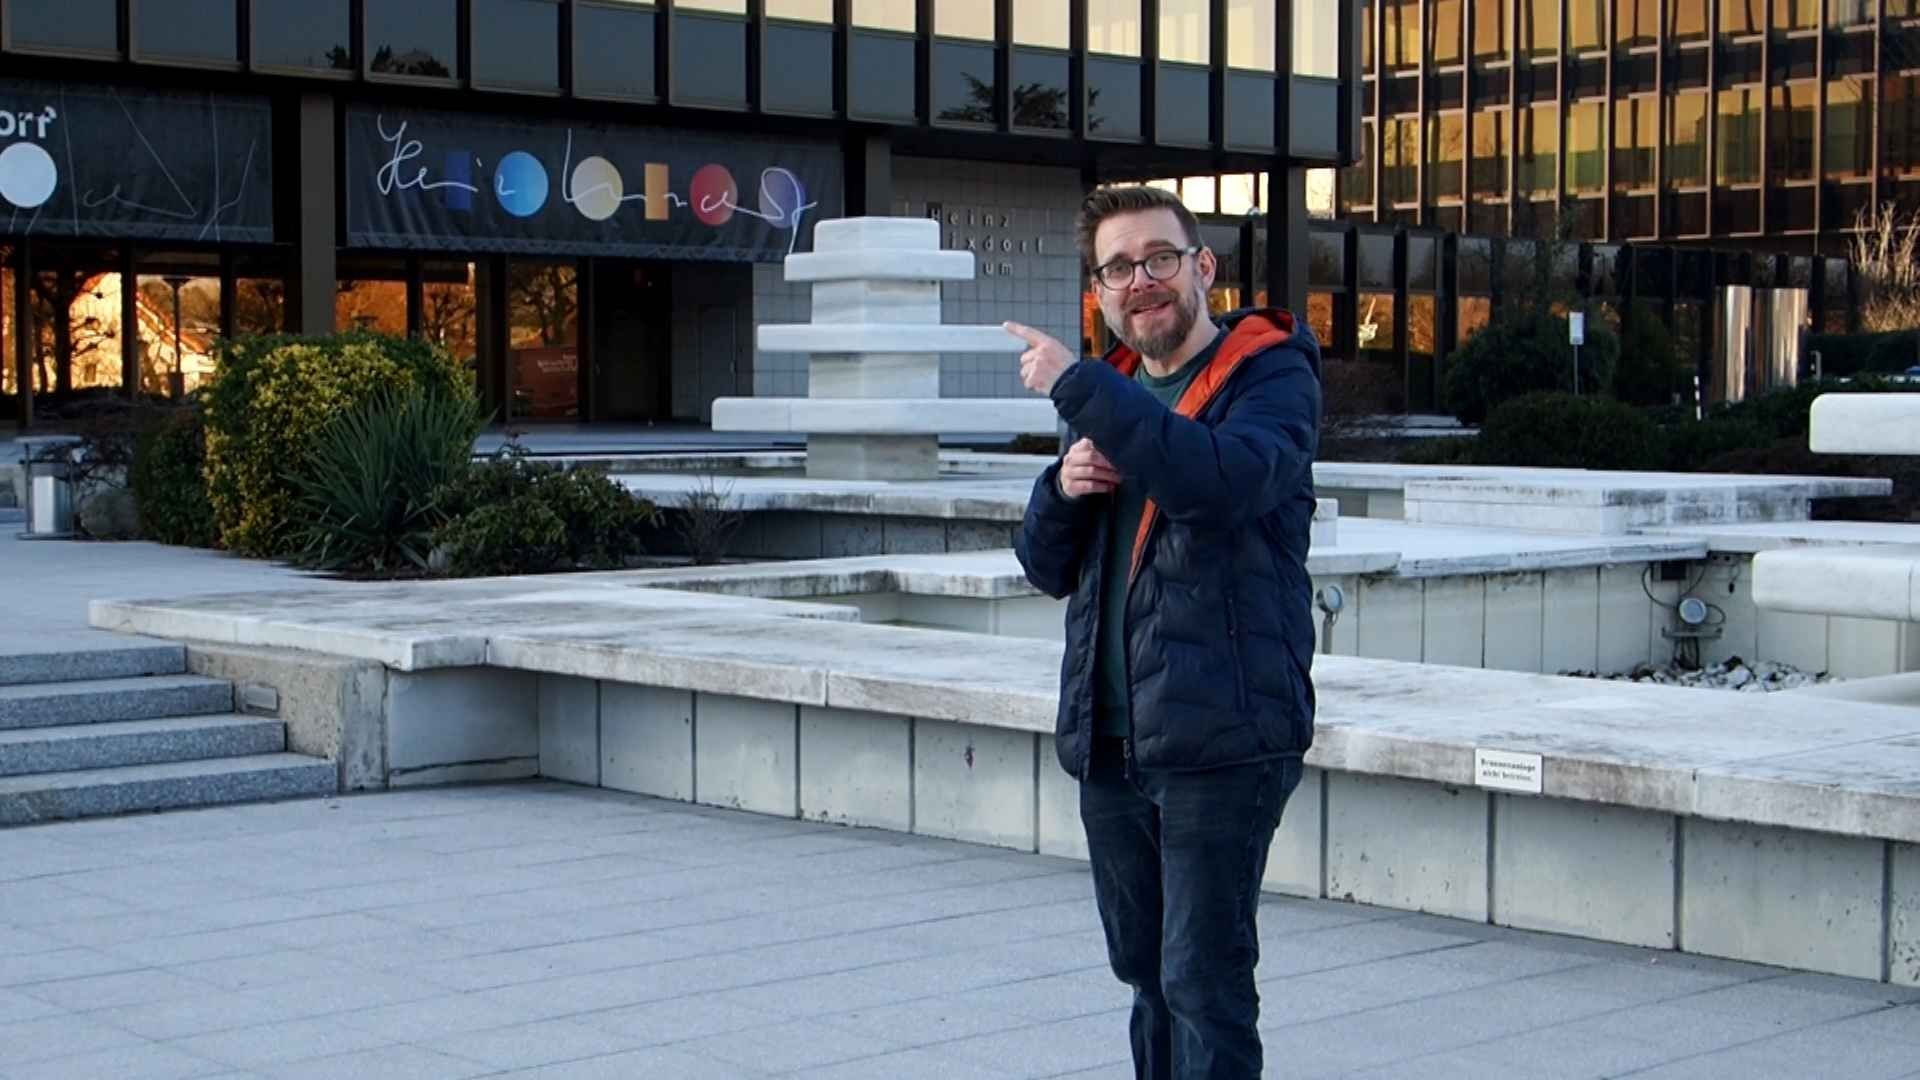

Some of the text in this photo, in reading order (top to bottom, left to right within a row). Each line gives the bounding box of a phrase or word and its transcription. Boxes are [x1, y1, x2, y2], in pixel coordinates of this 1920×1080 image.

[0, 106, 57, 138] orf
[951, 232, 1043, 253] ixdorf
[984, 262, 1013, 276] um
